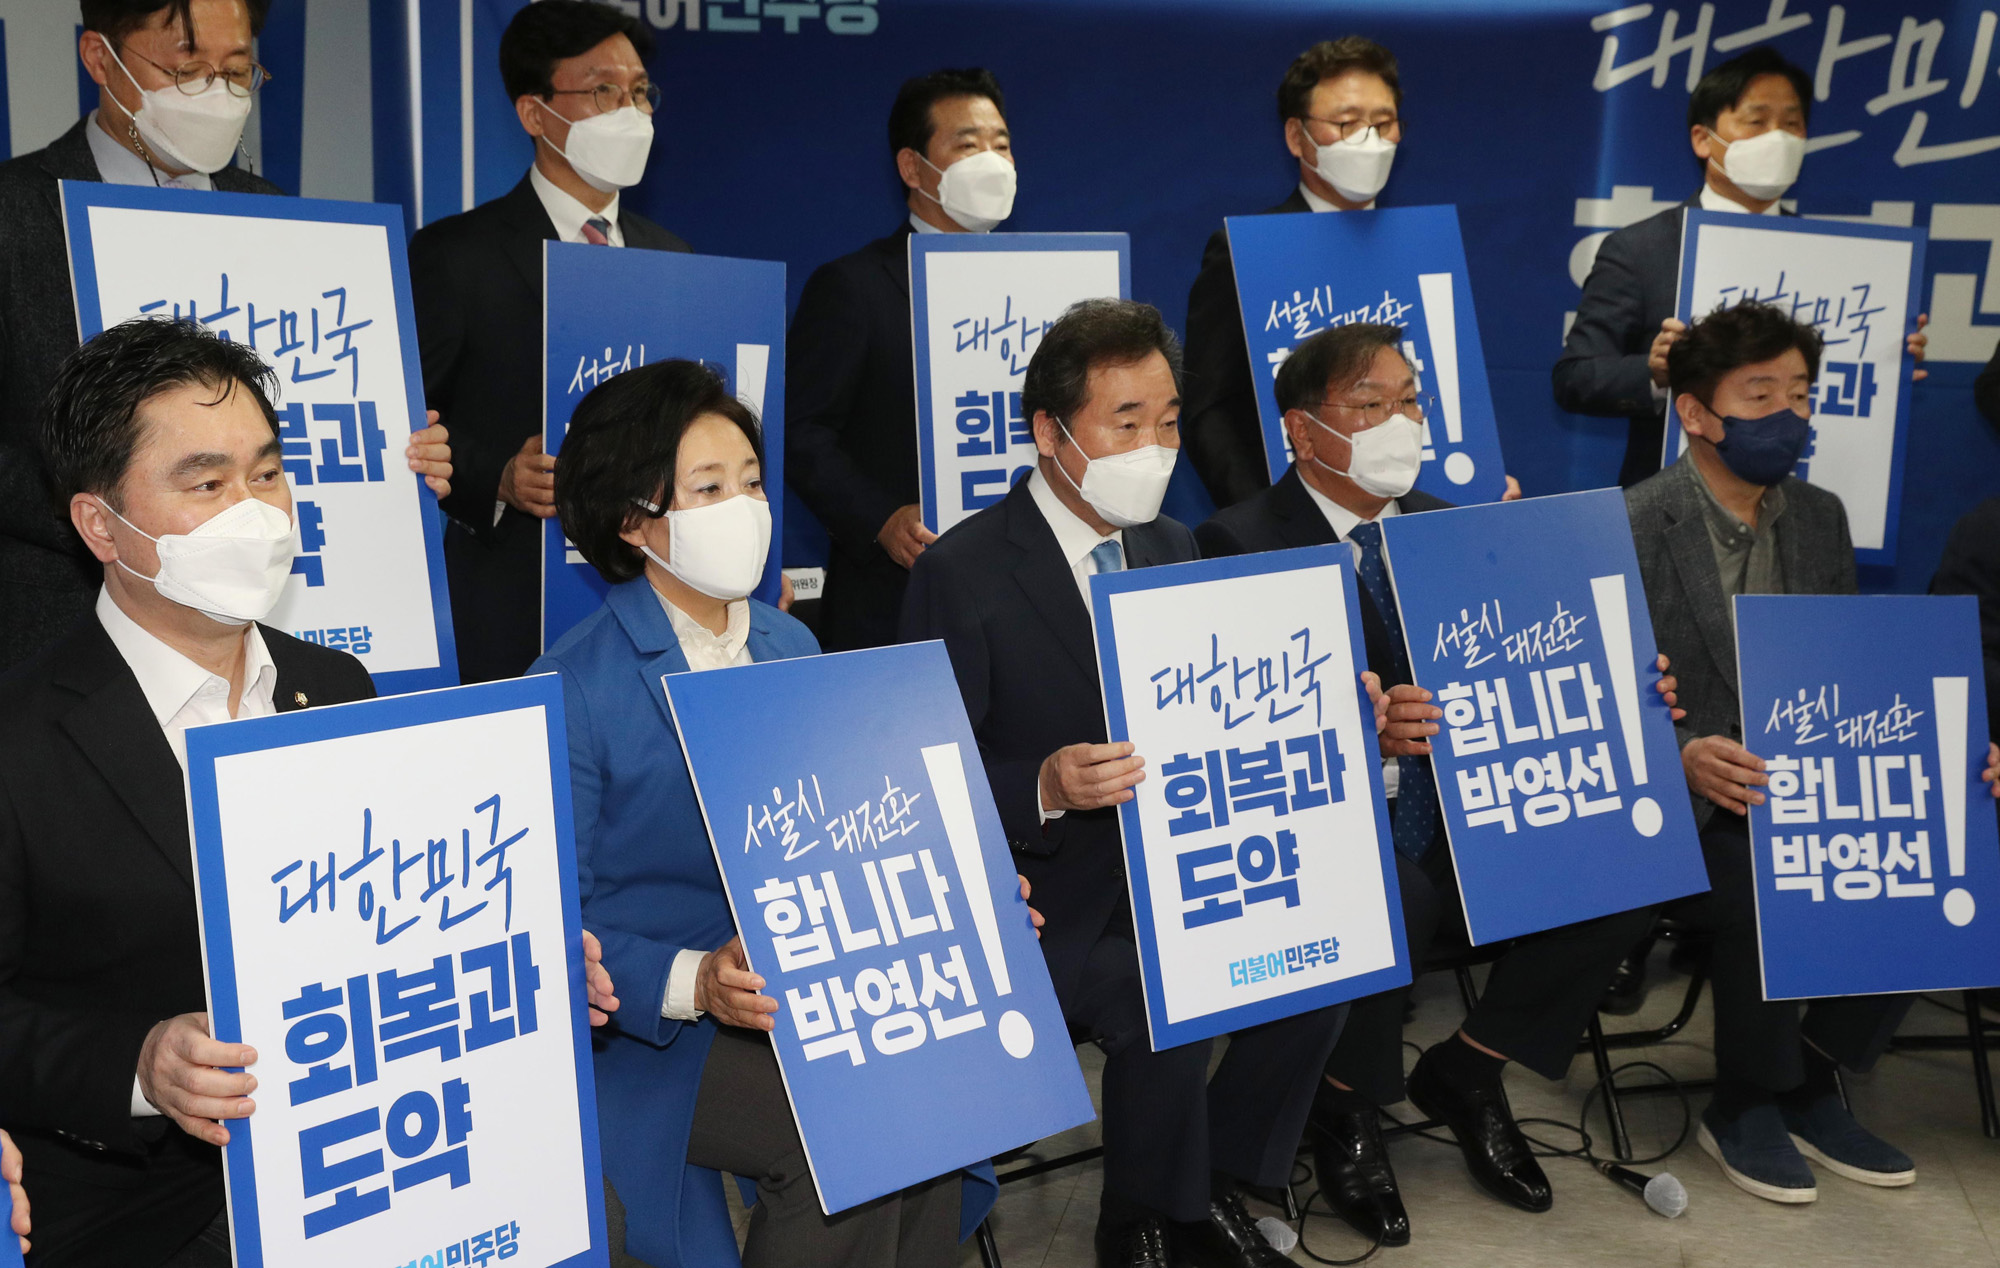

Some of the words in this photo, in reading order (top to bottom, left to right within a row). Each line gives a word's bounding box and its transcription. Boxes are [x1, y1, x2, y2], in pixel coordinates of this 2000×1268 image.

[1265, 285, 1333, 340] 서울시
[1150, 628, 1332, 730] 대한민국
[1432, 600, 1504, 670] 서울시
[1502, 601, 1588, 666] 대전환
[1438, 662, 1605, 757] 합니다
[1764, 683, 1840, 746] 서울시
[1835, 692, 1925, 749] 대전환
[745, 774, 826, 861] 서울시
[825, 775, 921, 853] 대전환
[1161, 728, 1346, 837] 회복과
[1456, 734, 1623, 834] 박영선
[1766, 754, 1932, 824] 합니다
[271, 793, 530, 945] 대한민국
[753, 848, 956, 973] 합니다
[1176, 829, 1300, 930] 도약
[1771, 831, 1935, 902] 박영선
[785, 944, 988, 1067] 박영선
[1229, 936, 1340, 988] 더불어민주당
[281, 931, 541, 1106] 회복과
[299, 1078, 473, 1240] 도약
